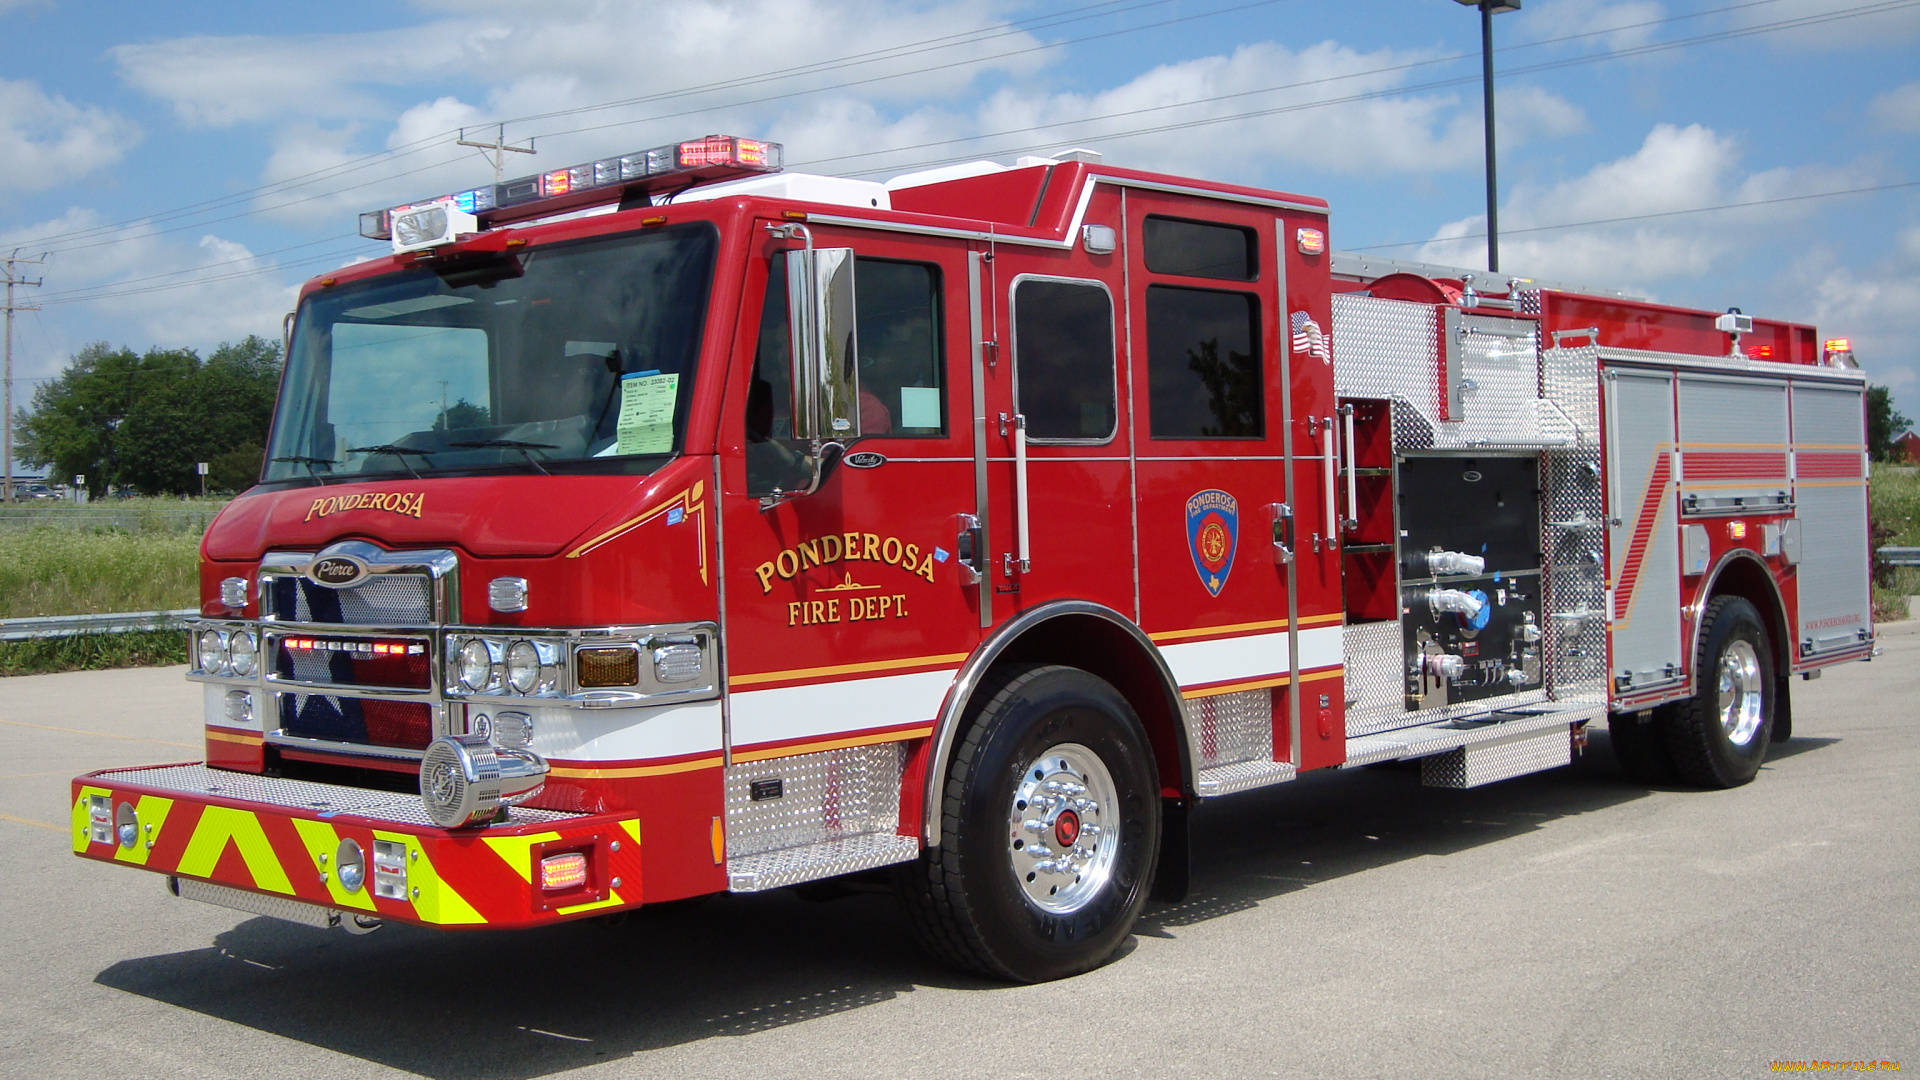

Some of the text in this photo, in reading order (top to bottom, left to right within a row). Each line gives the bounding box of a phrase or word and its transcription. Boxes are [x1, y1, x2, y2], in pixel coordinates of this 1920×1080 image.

[304, 492, 425, 522] PONDEROSA
[1187, 492, 1236, 514] PONDEROSA
[1190, 503, 1236, 519] FIRE DEPARTMENT
[317, 560, 355, 578] Pierce
[755, 532, 935, 595] PONDEROSA
[788, 594, 909, 626] FIRE DEPT.
